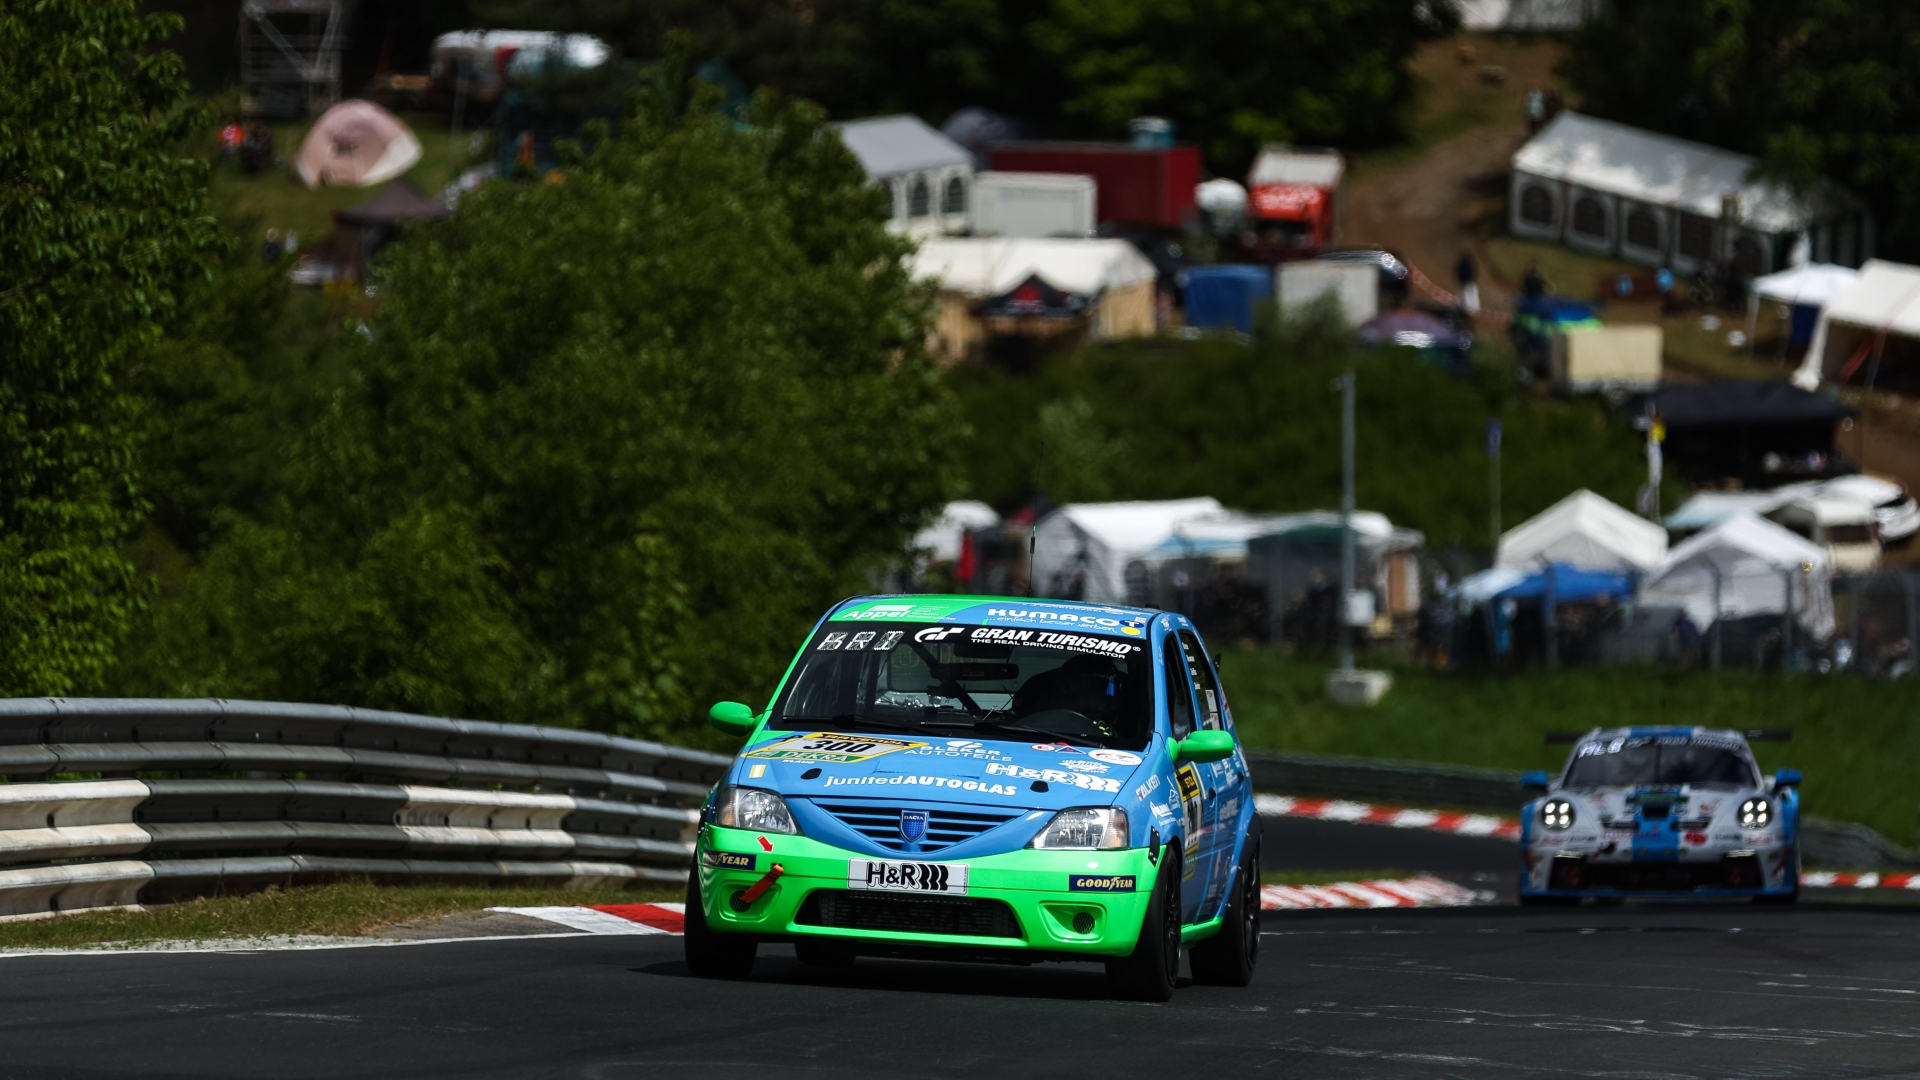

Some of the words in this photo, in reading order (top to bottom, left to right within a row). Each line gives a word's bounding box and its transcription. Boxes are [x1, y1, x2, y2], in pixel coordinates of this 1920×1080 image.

[842, 610, 910, 620] Appel
[971, 627, 1032, 641] GRAN
[993, 639, 1021, 647] REAL
[1022, 641, 1065, 650] DRIVING
[1066, 646, 1126, 660] SIMULATOR
[802, 740, 877, 753] 300
[782, 751, 848, 762] DEKRA
[903, 749, 1013, 762] AUTOTEILE
